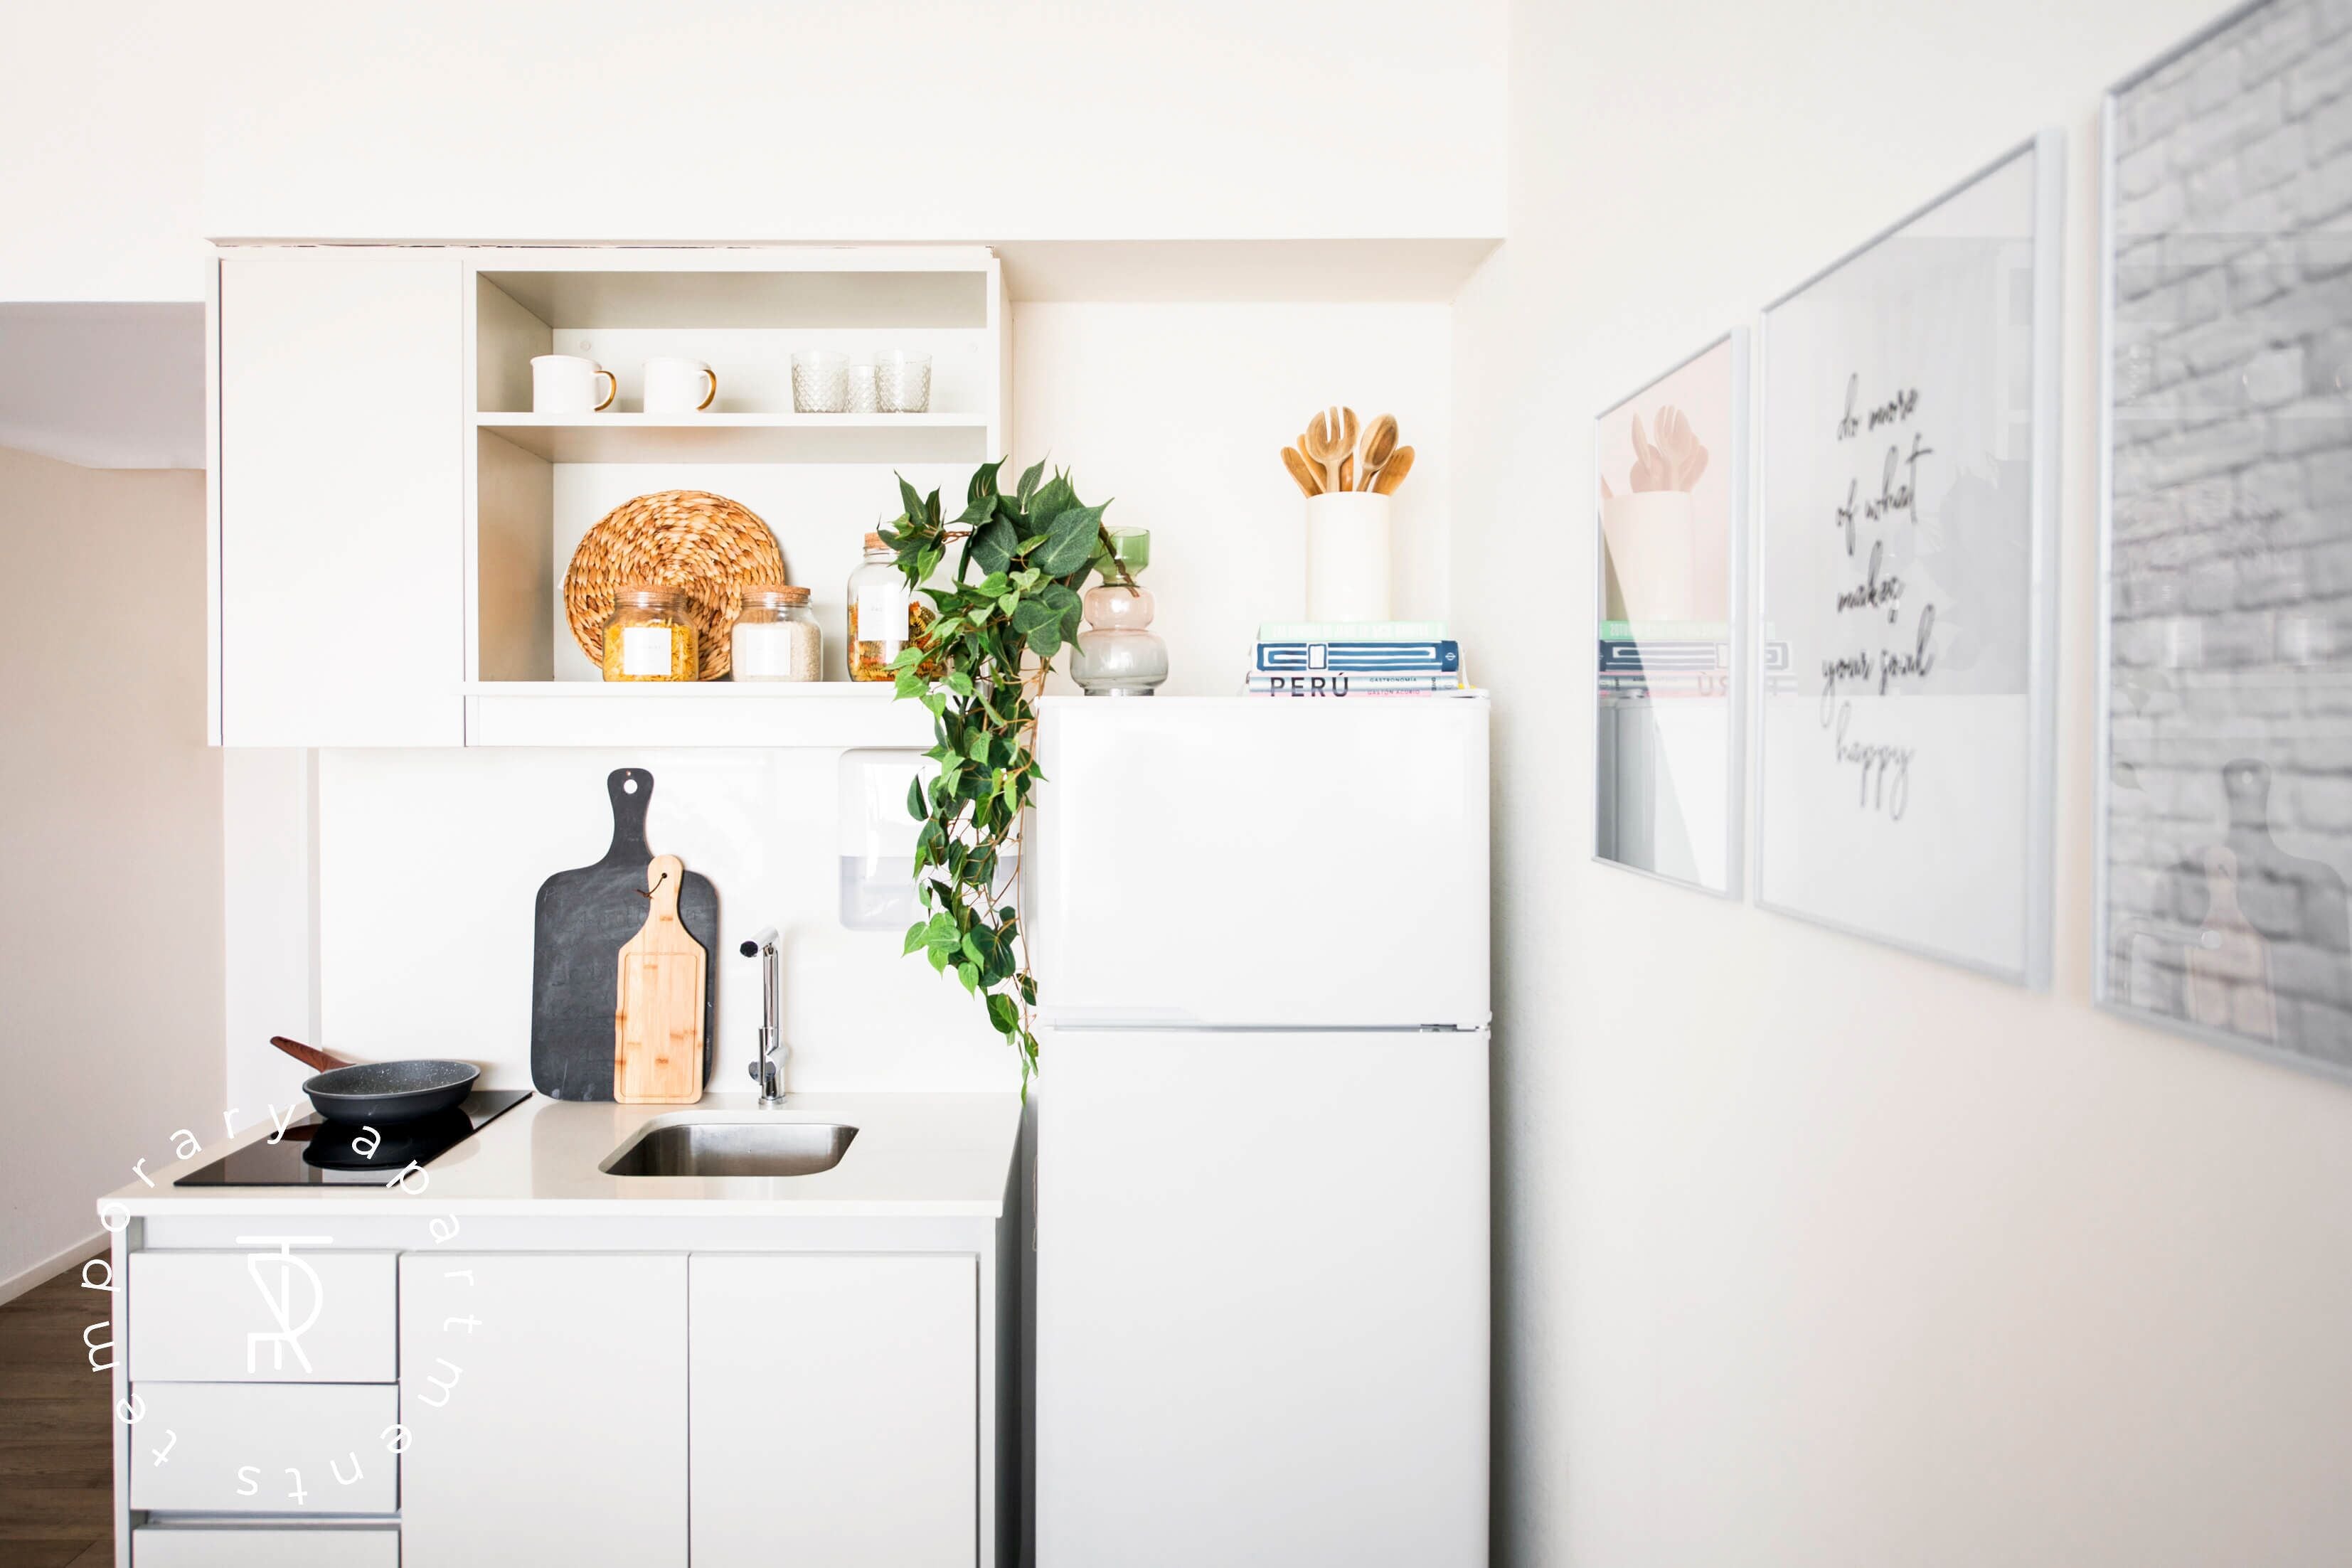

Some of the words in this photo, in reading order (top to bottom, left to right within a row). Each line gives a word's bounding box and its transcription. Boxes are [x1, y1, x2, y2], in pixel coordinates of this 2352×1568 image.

[1837, 372, 1859, 440] do
[1868, 389, 1919, 432] more
[1836, 478, 1858, 556] of
[1866, 432, 1933, 525] what
[1270, 672, 1349, 698] PERÚ
[1820, 650, 1873, 728] your
[1836, 700, 1915, 821] happy
